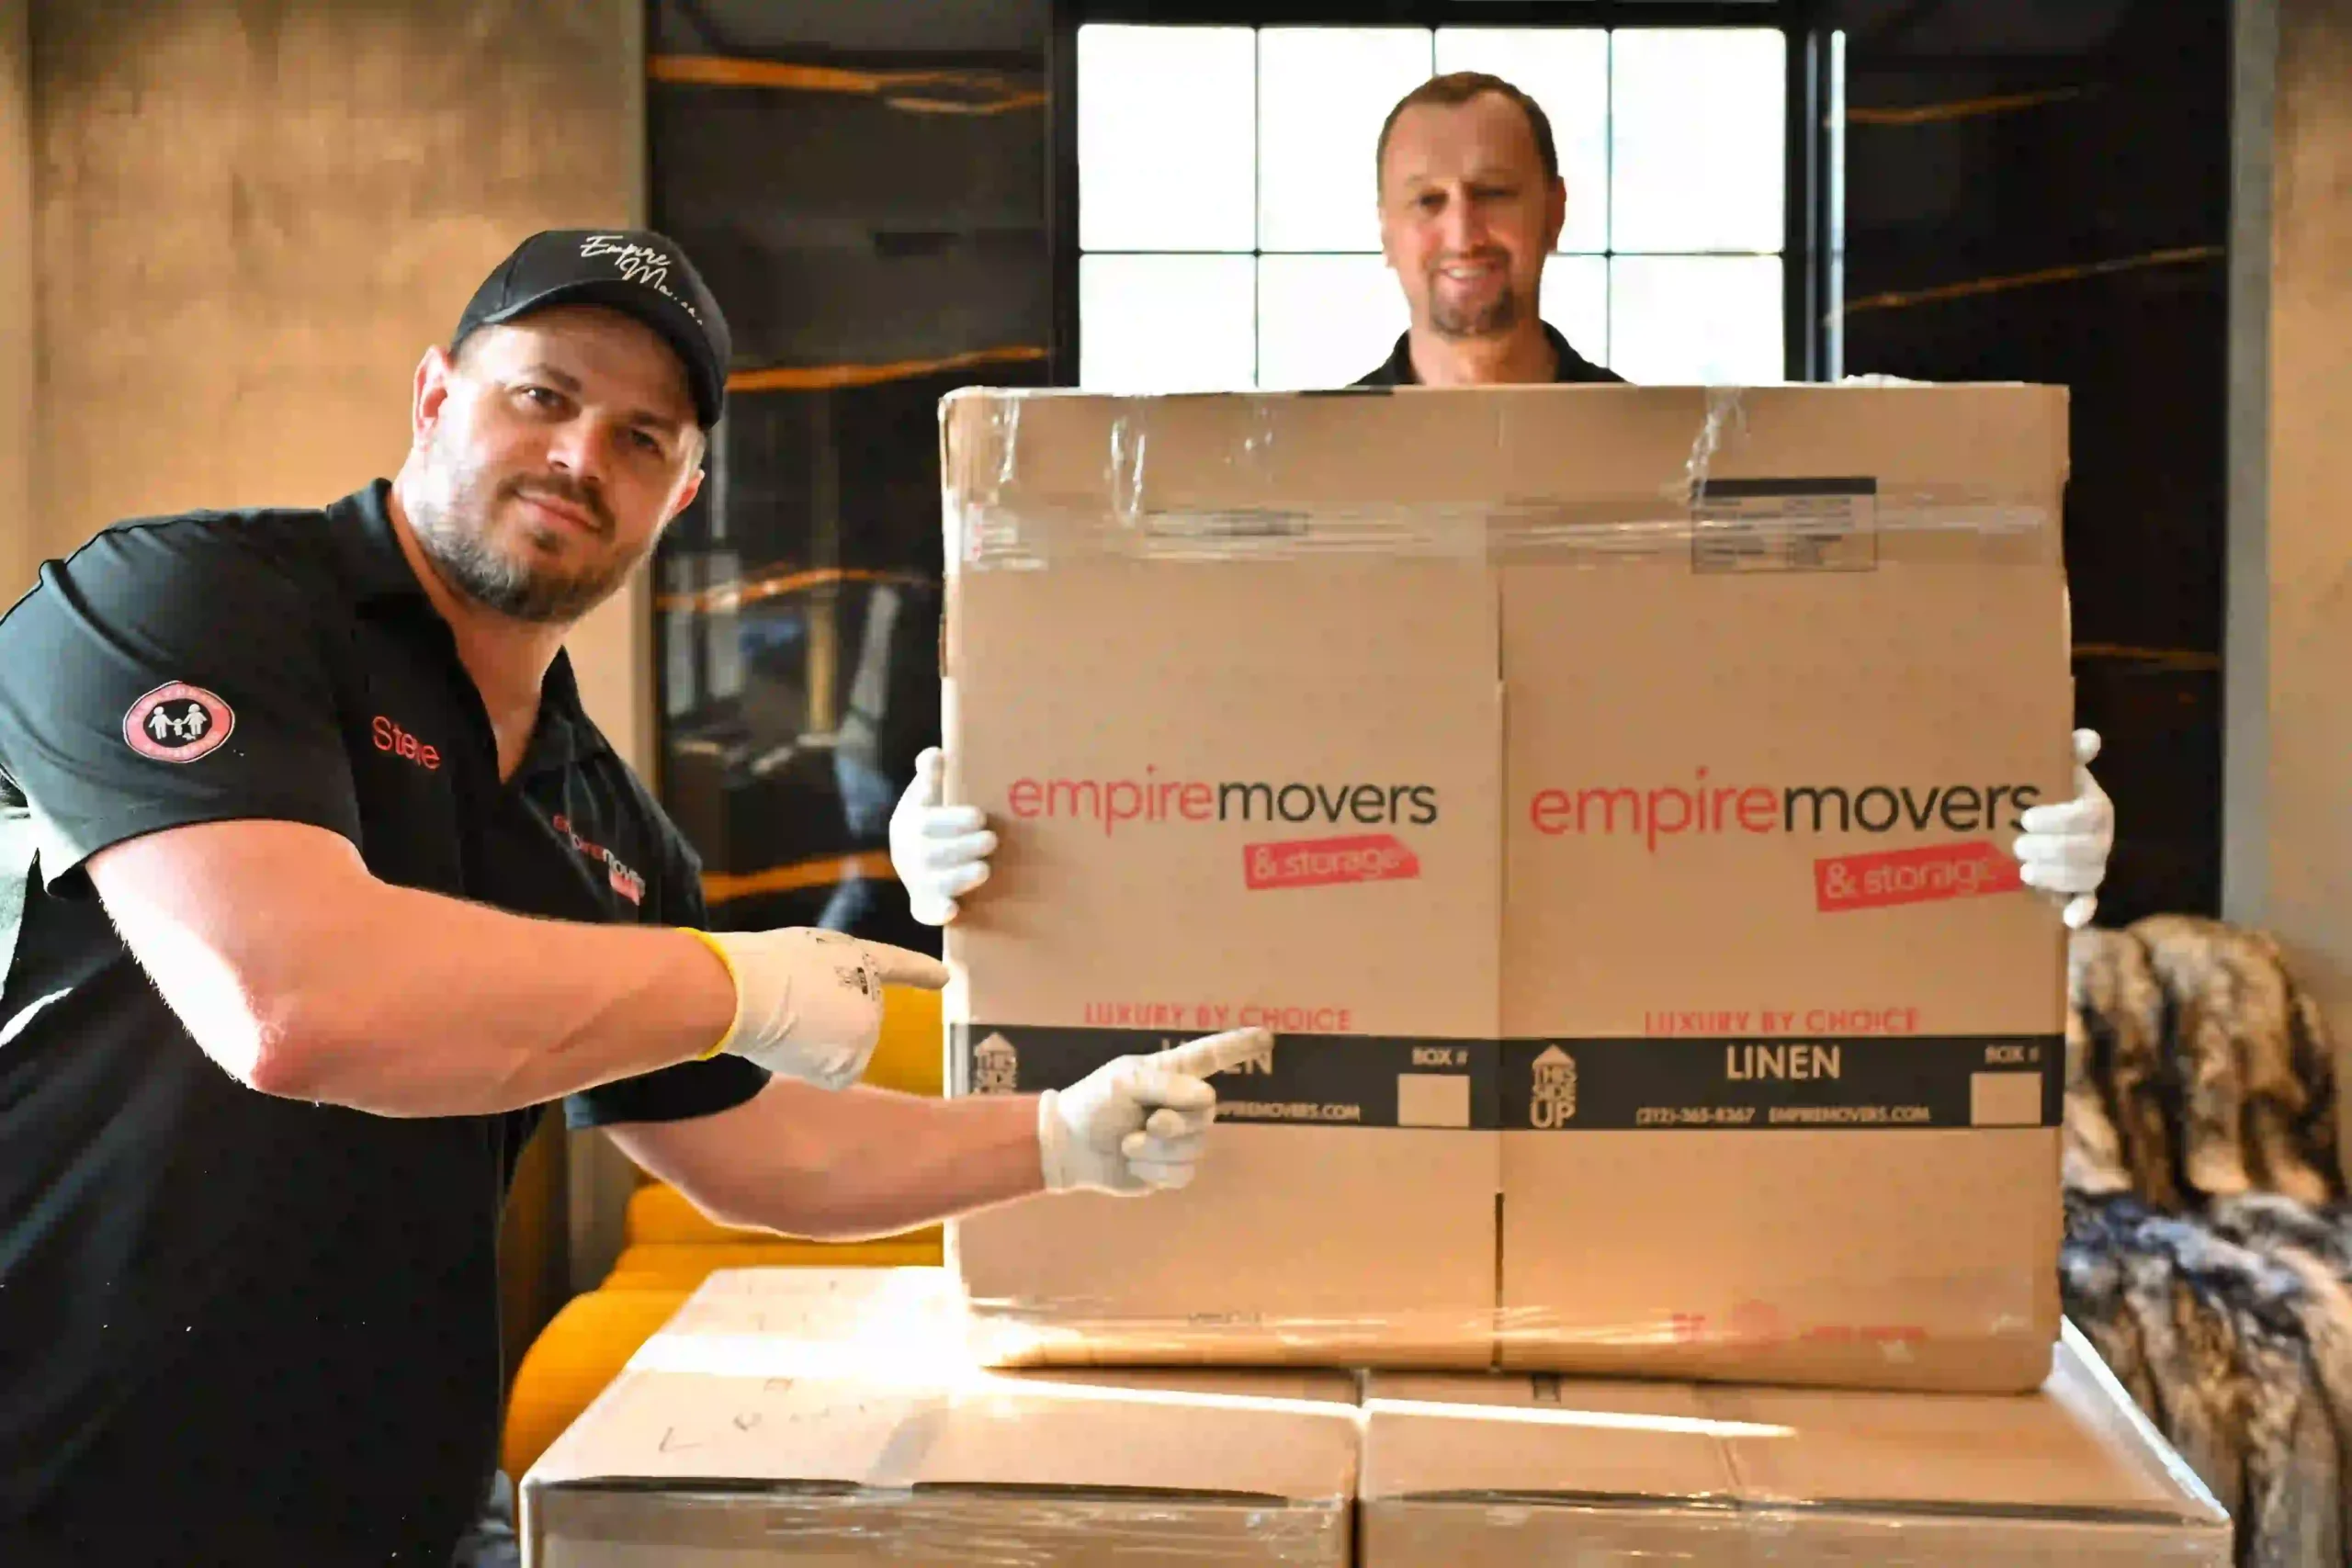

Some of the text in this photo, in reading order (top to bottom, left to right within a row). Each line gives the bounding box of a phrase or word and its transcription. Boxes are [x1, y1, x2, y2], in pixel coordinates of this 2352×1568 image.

[1008, 764, 1438, 839] empiremovers
[1530, 765, 2041, 853] empiremovers
[1253, 845, 1401, 880] & storage
[1825, 852, 1996, 898] & storage
[1083, 1002, 1351, 1032] LUXURY BY CHOICE
[1645, 1007, 1920, 1034] LUXURY BY CHOICE
[1412, 1046, 1453, 1066] BOX
[1725, 1043, 1841, 1080] LINEN
[1529, 1100, 1577, 1129] UP
